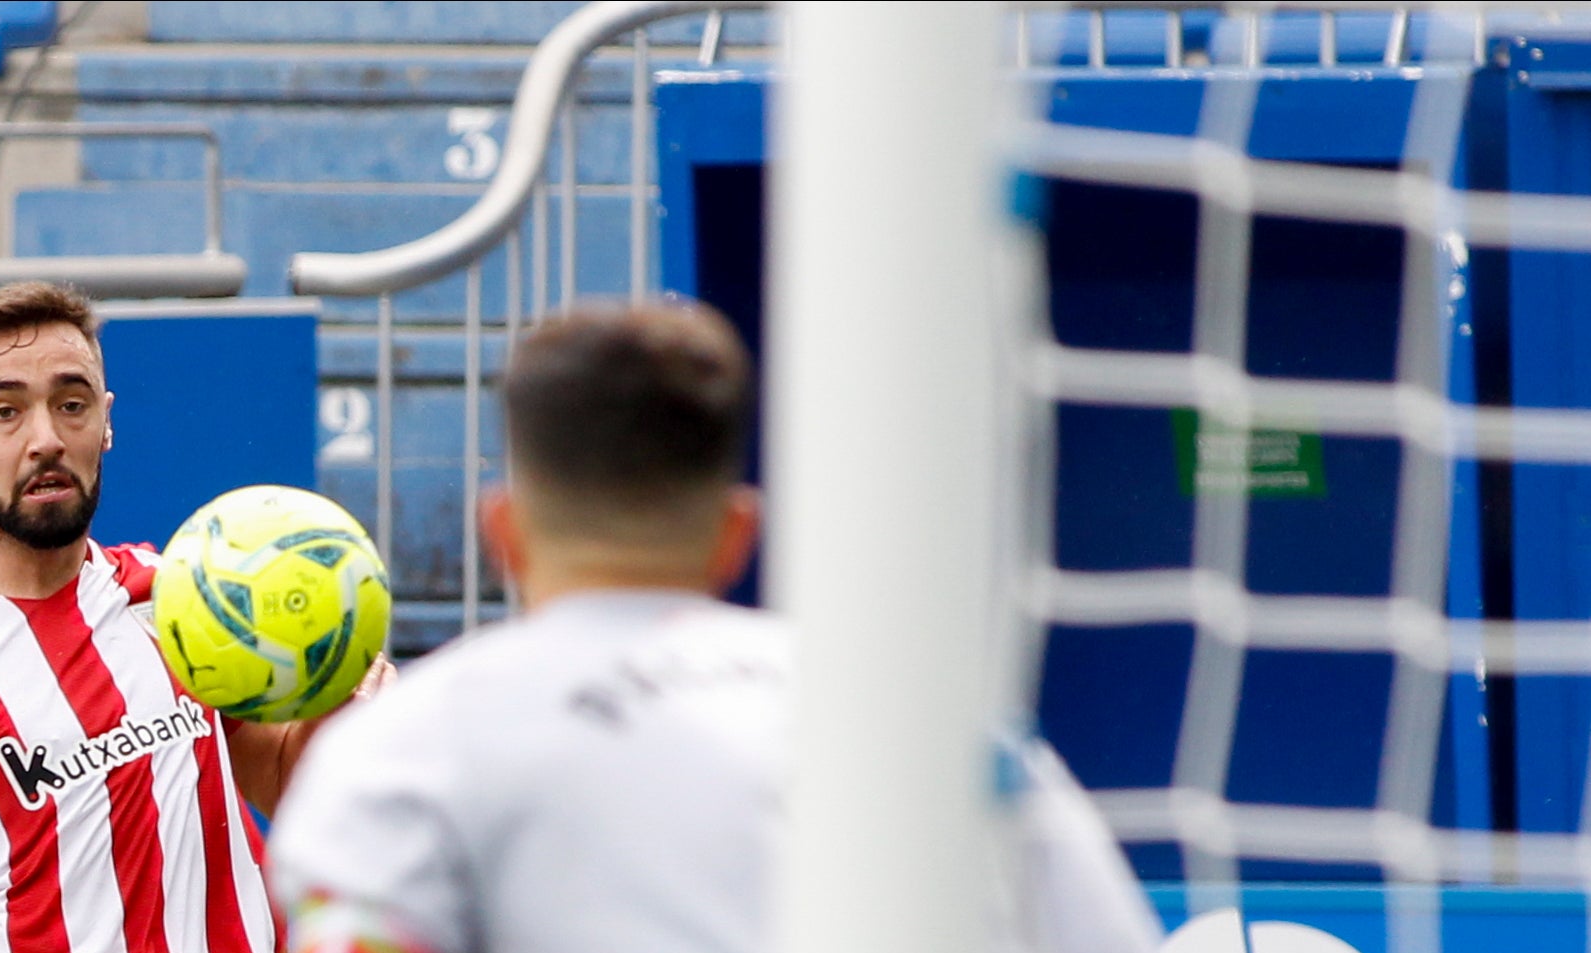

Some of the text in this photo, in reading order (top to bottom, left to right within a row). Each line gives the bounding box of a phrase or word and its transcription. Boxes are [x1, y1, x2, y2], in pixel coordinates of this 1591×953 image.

[444, 107, 499, 180] 3
[318, 387, 375, 460] 2
[0, 701, 208, 804] Kutxabank
